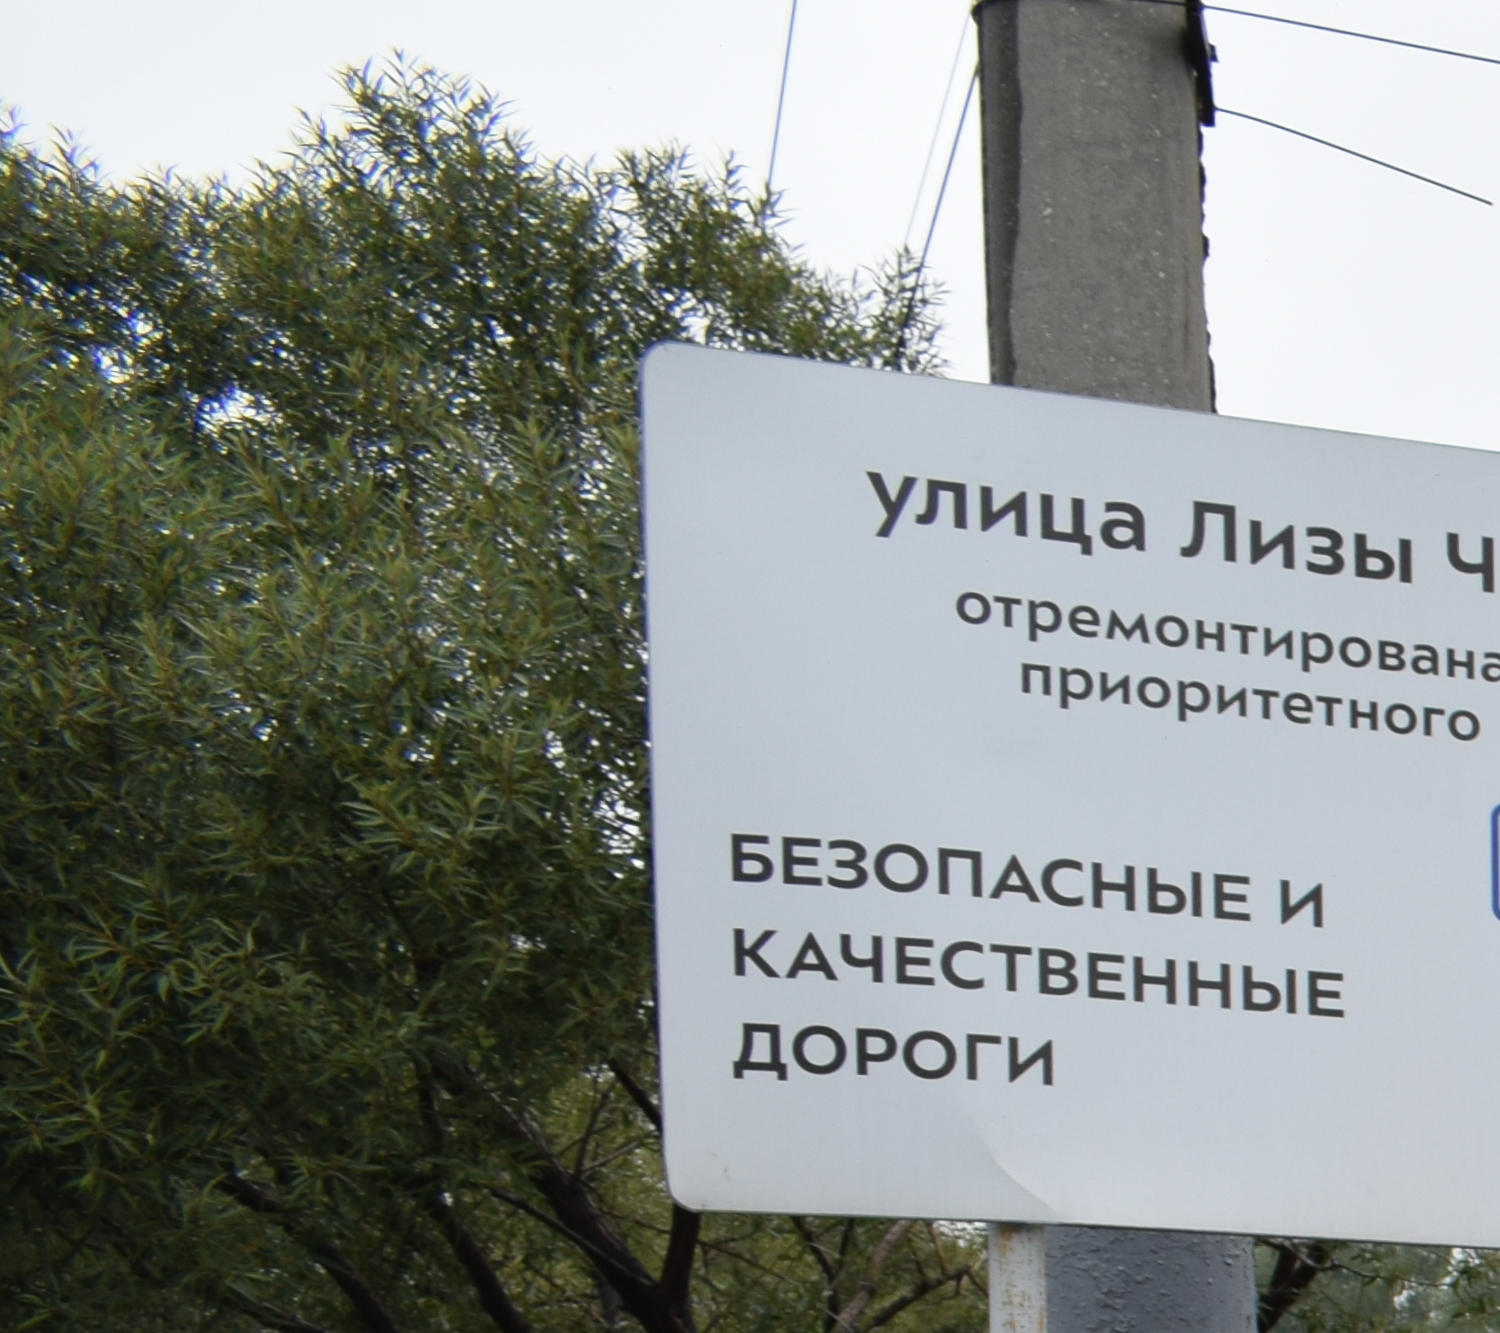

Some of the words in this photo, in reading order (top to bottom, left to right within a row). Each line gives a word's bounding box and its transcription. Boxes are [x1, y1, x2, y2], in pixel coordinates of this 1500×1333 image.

[866, 471, 1146, 556] улица
[1180, 500, 1413, 584] Лизы
[1021, 661, 1482, 742] приоритетного
[730, 833, 1252, 924] БЕЗОПАСНЫЕ
[1280, 879, 1324, 928] И
[732, 927, 1346, 1020] КАЧЕСТВЕННЫЕ
[732, 1021, 1054, 1087] ДОРОГИ
